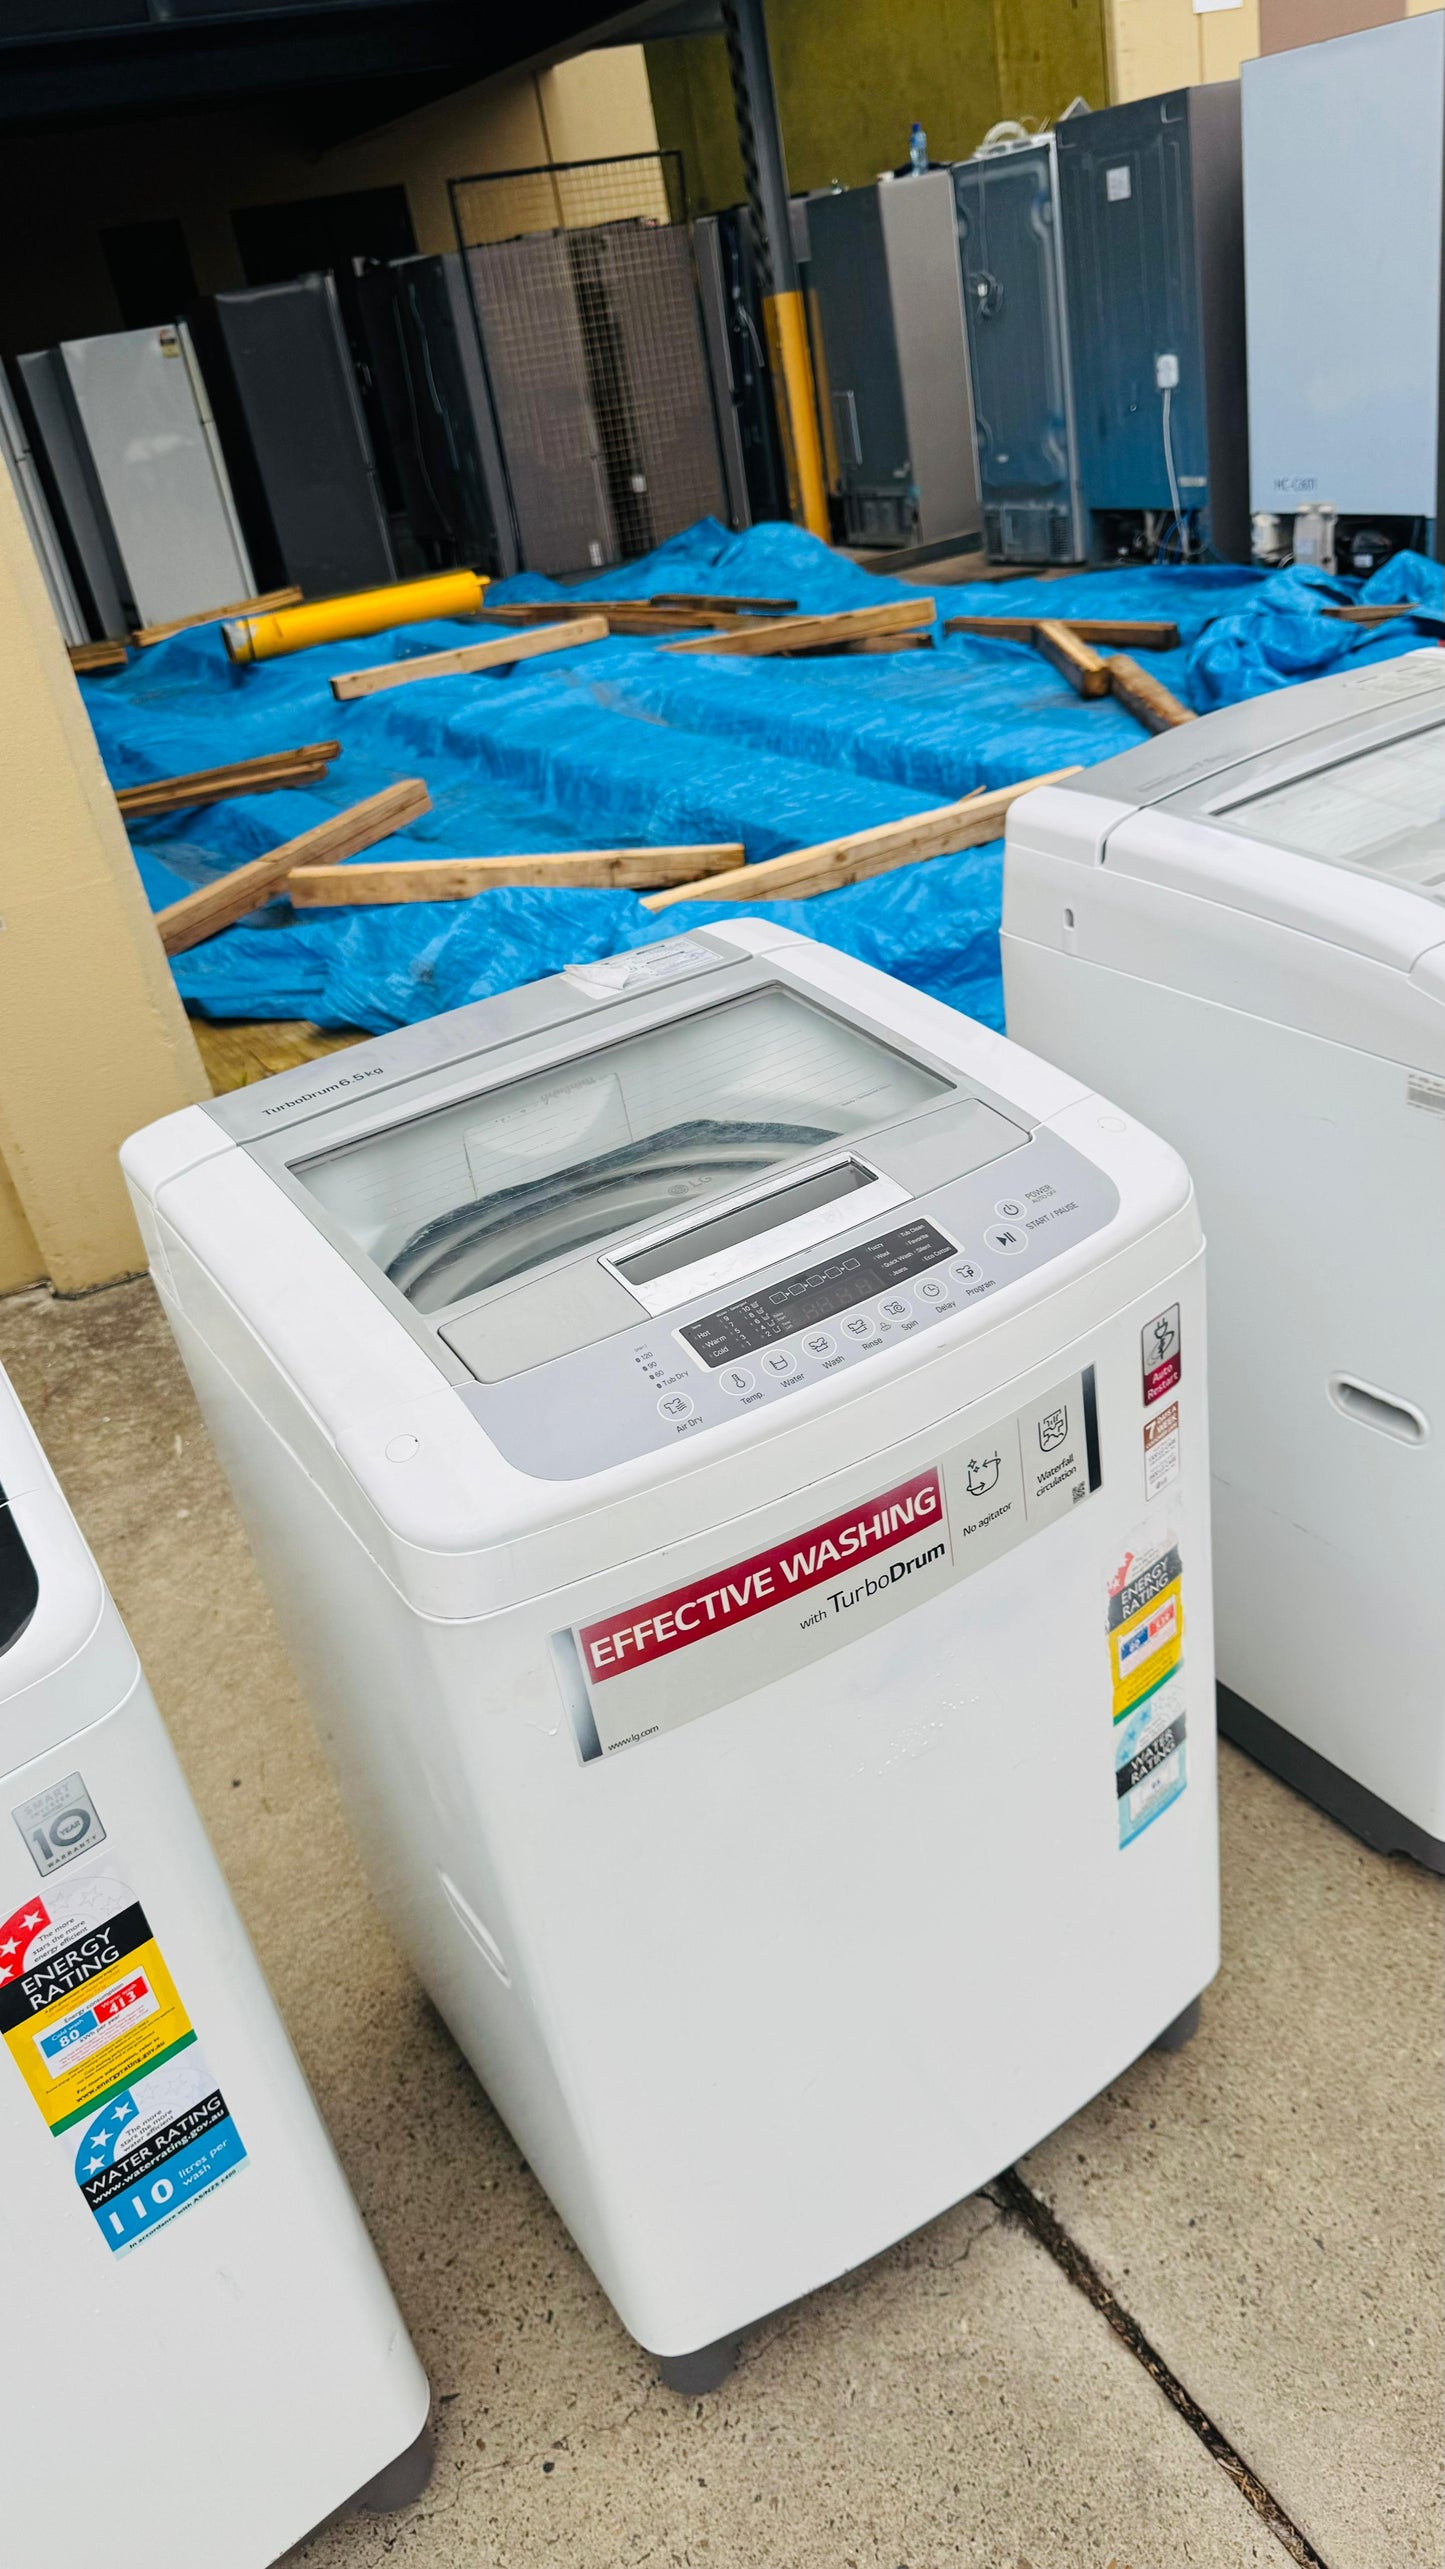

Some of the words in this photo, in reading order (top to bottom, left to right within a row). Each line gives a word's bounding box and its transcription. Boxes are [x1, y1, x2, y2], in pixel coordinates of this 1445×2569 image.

[262, 1084, 340, 1116] TurboDrum
[339, 1073, 364, 1087] 6.5
[364, 1067, 385, 1078] kg
[688, 1176, 713, 1187] LG
[1025, 1184, 1053, 1200] POWER
[1025, 1214, 1050, 1230] START
[1053, 1201, 1080, 1217] PAUSE
[965, 1279, 996, 1296] Program
[935, 1300, 957, 1313] Delay
[697, 1330, 711, 1340] Hot
[901, 1319, 919, 1332] Spin
[705, 1335, 727, 1348] Warm
[713, 1346, 729, 1358] Cold
[861, 1337, 883, 1351] Rinse
[640, 1352, 654, 1361] 120
[647, 1361, 658, 1369] 90
[822, 1354, 845, 1369] Wash
[654, 1370, 665, 1378] 60
[662, 1376, 677, 1387] Tub
[675, 1370, 689, 1381] Dry
[780, 1372, 805, 1388] Water
[1147, 1372, 1178, 1400] Restart
[1152, 1364, 1173, 1384] Auto
[740, 1391, 765, 1405] Temp.
[676, 1423, 688, 1433] Air
[688, 1416, 704, 1427] Dry
[1145, 1420, 1156, 1440] 7
[1036, 1453, 1074, 1484] Waterfall
[1036, 1466, 1077, 1497] circulation
[963, 1523, 977, 1537] No
[978, 1502, 1012, 1528] agitator
[590, 1567, 775, 1668] EFFECTIVE
[779, 1486, 937, 1583] WASHING
[799, 1610, 828, 1630] with
[827, 1543, 945, 1614] TurboDrum
[1121, 1557, 1168, 1605] ENERGY
[1122, 1572, 1169, 1619] RATING
[608, 1723, 659, 1751] www.lg.com
[1130, 1728, 1174, 1770] WATER
[1131, 1741, 1175, 1784] RATING
[33, 1808, 91, 1860] 10
[60, 1820, 81, 1835] YEAR
[48, 1835, 96, 1868] WARRANTY
[32, 1943, 50, 1955] stars
[52, 1934, 64, 1943] the
[65, 1920, 86, 1935] more
[38, 1931, 53, 1941] The
[55, 1918, 75, 1933] more
[34, 1946, 58, 1962] energy
[60, 1926, 88, 1946] efficient
[21, 1927, 112, 1996] ENERGY
[29, 1945, 120, 2011] RATING
[63, 2007, 85, 2023] Energy
[87, 1983, 124, 2009] consumption
[109, 1990, 137, 2014] 413
[59, 2029, 80, 2047] 80
[76, 2040, 165, 2102] www.energyrating.gov.au
[120, 2134, 138, 2147] stars
[140, 2125, 151, 2134] the
[153, 2110, 172, 2125] more
[126, 2125, 141, 2136] The
[142, 2110, 162, 2125] more
[86, 2146, 154, 2194] WATER
[155, 2096, 221, 2149] RATING
[92, 2108, 225, 2204] www.waterrating.gov.au
[124, 2136, 144, 2151] water
[178, 2155, 208, 2179] litres
[210, 2140, 228, 2160] per
[182, 2164, 211, 2187] wash
[109, 2179, 174, 2235] 110
[178, 2203, 192, 2215] with
